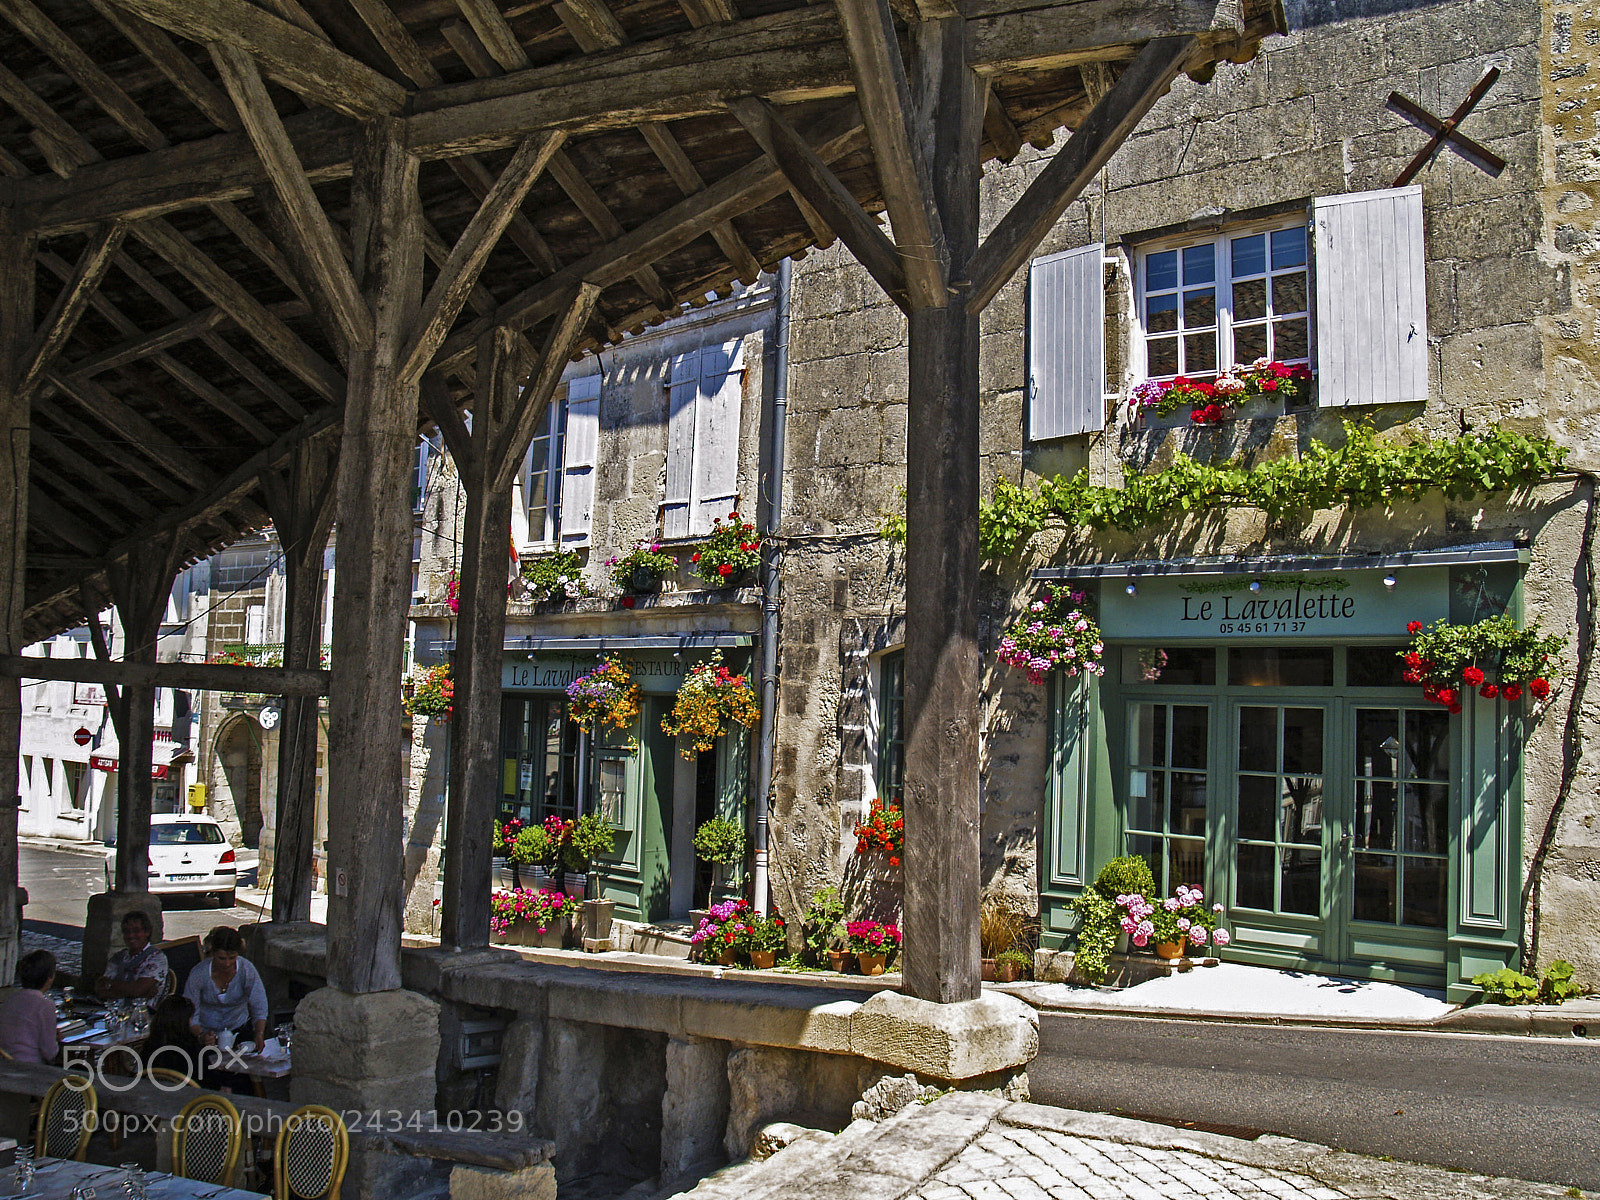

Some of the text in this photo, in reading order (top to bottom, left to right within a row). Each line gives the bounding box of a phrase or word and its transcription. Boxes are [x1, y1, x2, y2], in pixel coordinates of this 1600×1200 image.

[1181, 586, 1356, 620] Le Lavalette
[1219, 621, 1306, 633] 05 45 61 71 37
[511, 666, 529, 686] Le
[532, 660, 597, 686] Lavalet
